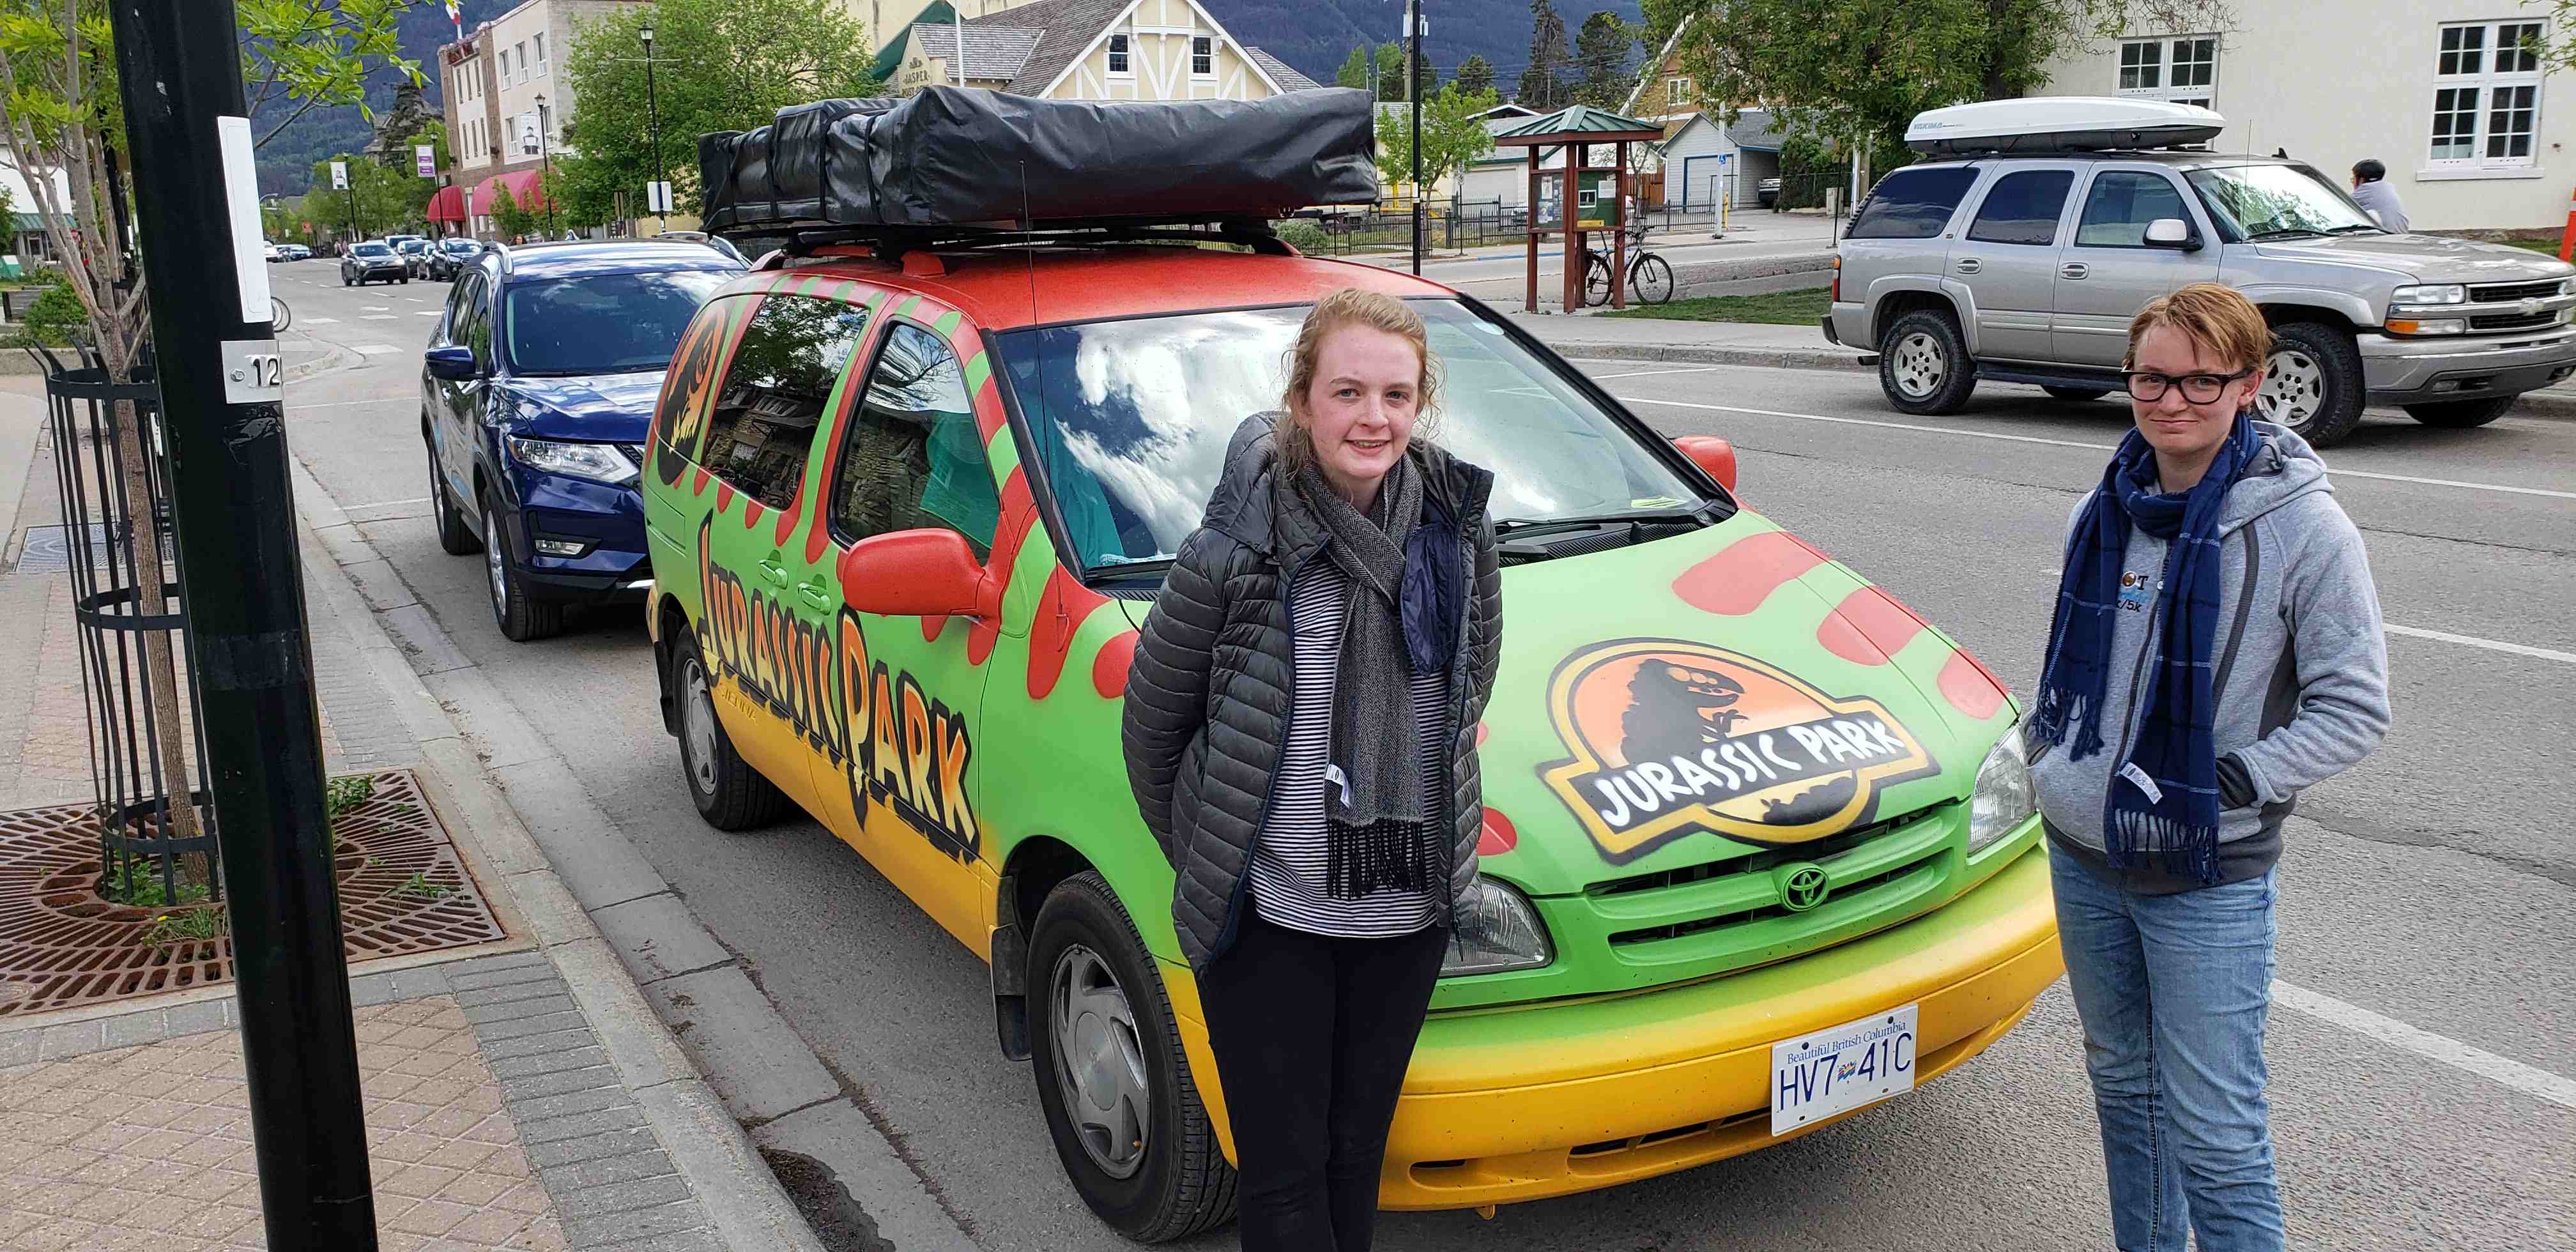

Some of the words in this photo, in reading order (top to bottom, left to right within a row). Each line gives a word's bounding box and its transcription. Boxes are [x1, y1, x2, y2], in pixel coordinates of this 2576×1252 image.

[905, 69, 929, 85] JASPER
[250, 357, 280, 387] 12
[697, 508, 845, 761] JURASSIC
[837, 603, 980, 865] PARK
[1594, 734, 1802, 827] JURASSIC
[1787, 717, 1906, 764] PARK
[1780, 1053, 1839, 1111] HV7
[1857, 1032, 1912, 1082] 41C
[1787, 1042, 1830, 1065] Beautiful
[1832, 1034, 1862, 1053] British
[1863, 1022, 1906, 1042] Columbia
